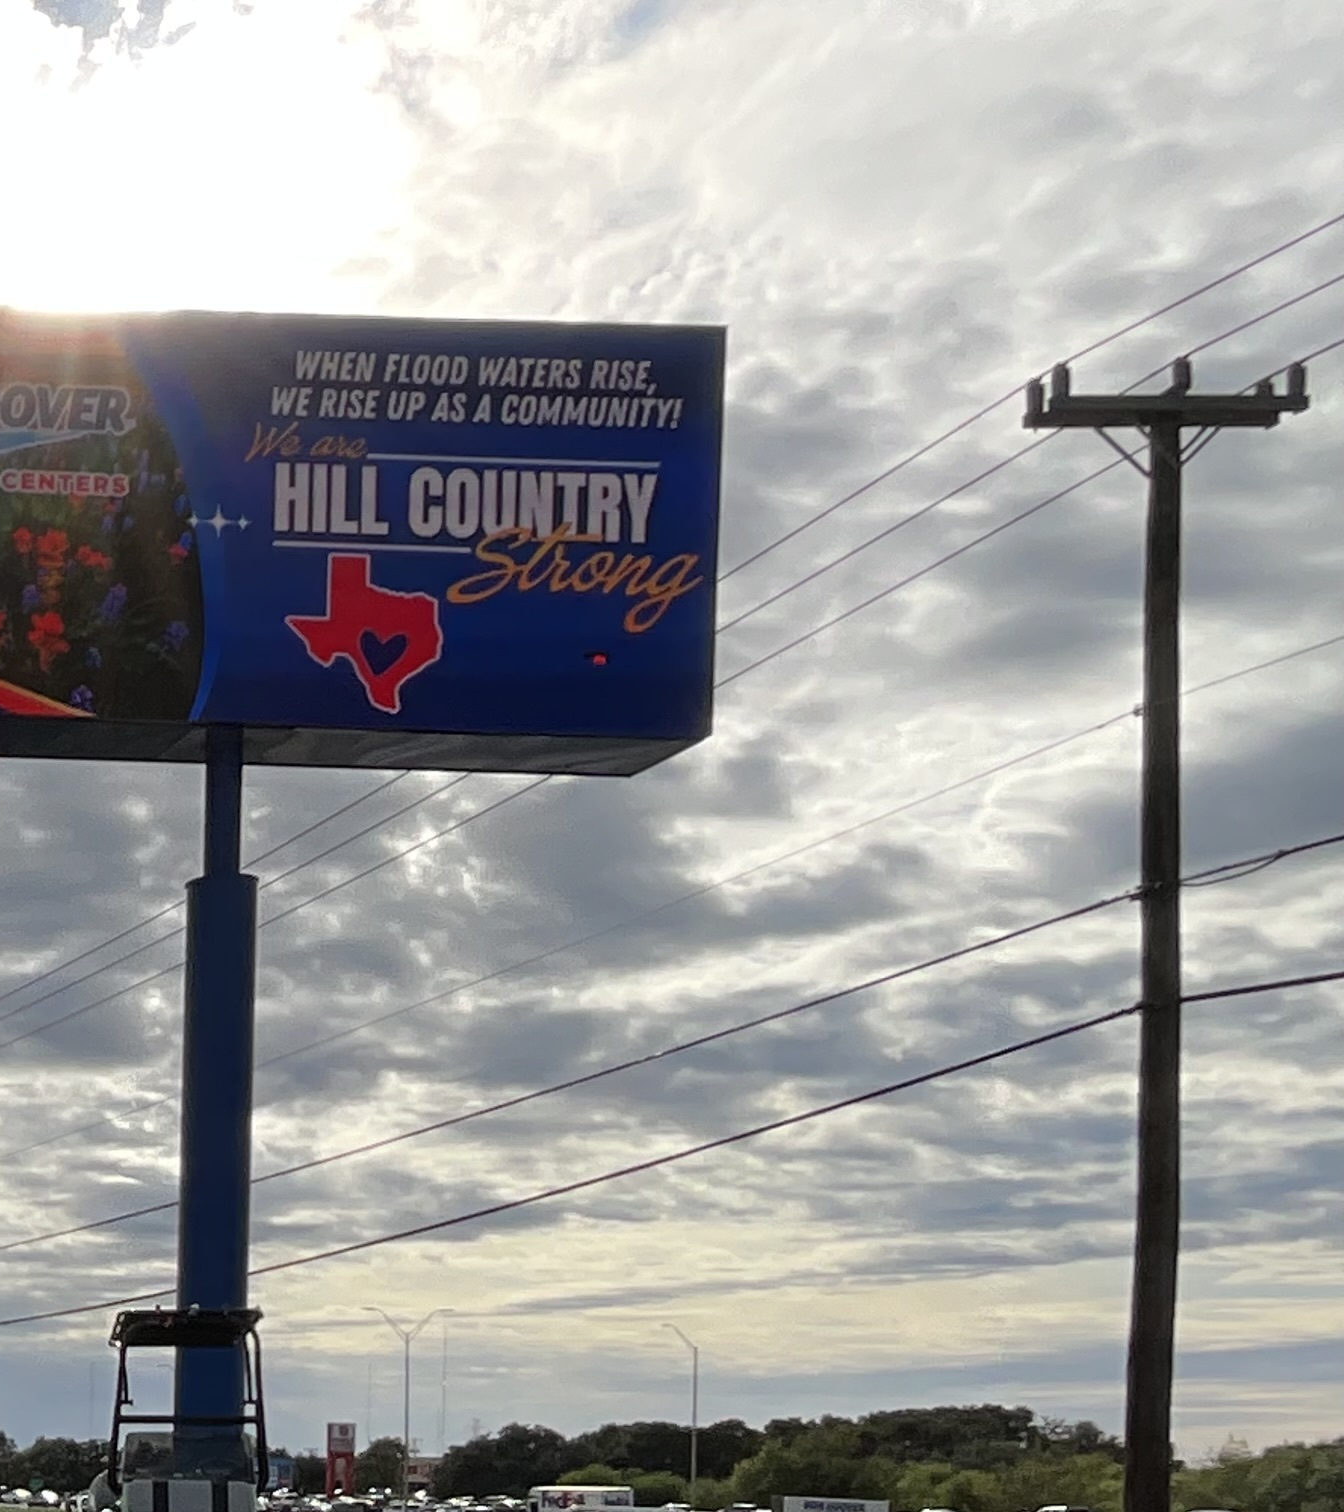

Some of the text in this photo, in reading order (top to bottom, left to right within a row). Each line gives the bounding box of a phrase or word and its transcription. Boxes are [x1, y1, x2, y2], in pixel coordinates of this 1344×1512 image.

[294, 350, 658, 395] WHEN FLOOD WATERS RISE,
[270, 387, 685, 429] WE RISE UP AS A COMMUNITY!
[244, 420, 368, 462] We are
[0, 468, 130, 497] CENTERS
[273, 462, 660, 544] HILL COUNTRY
[446, 521, 705, 634] Strong
